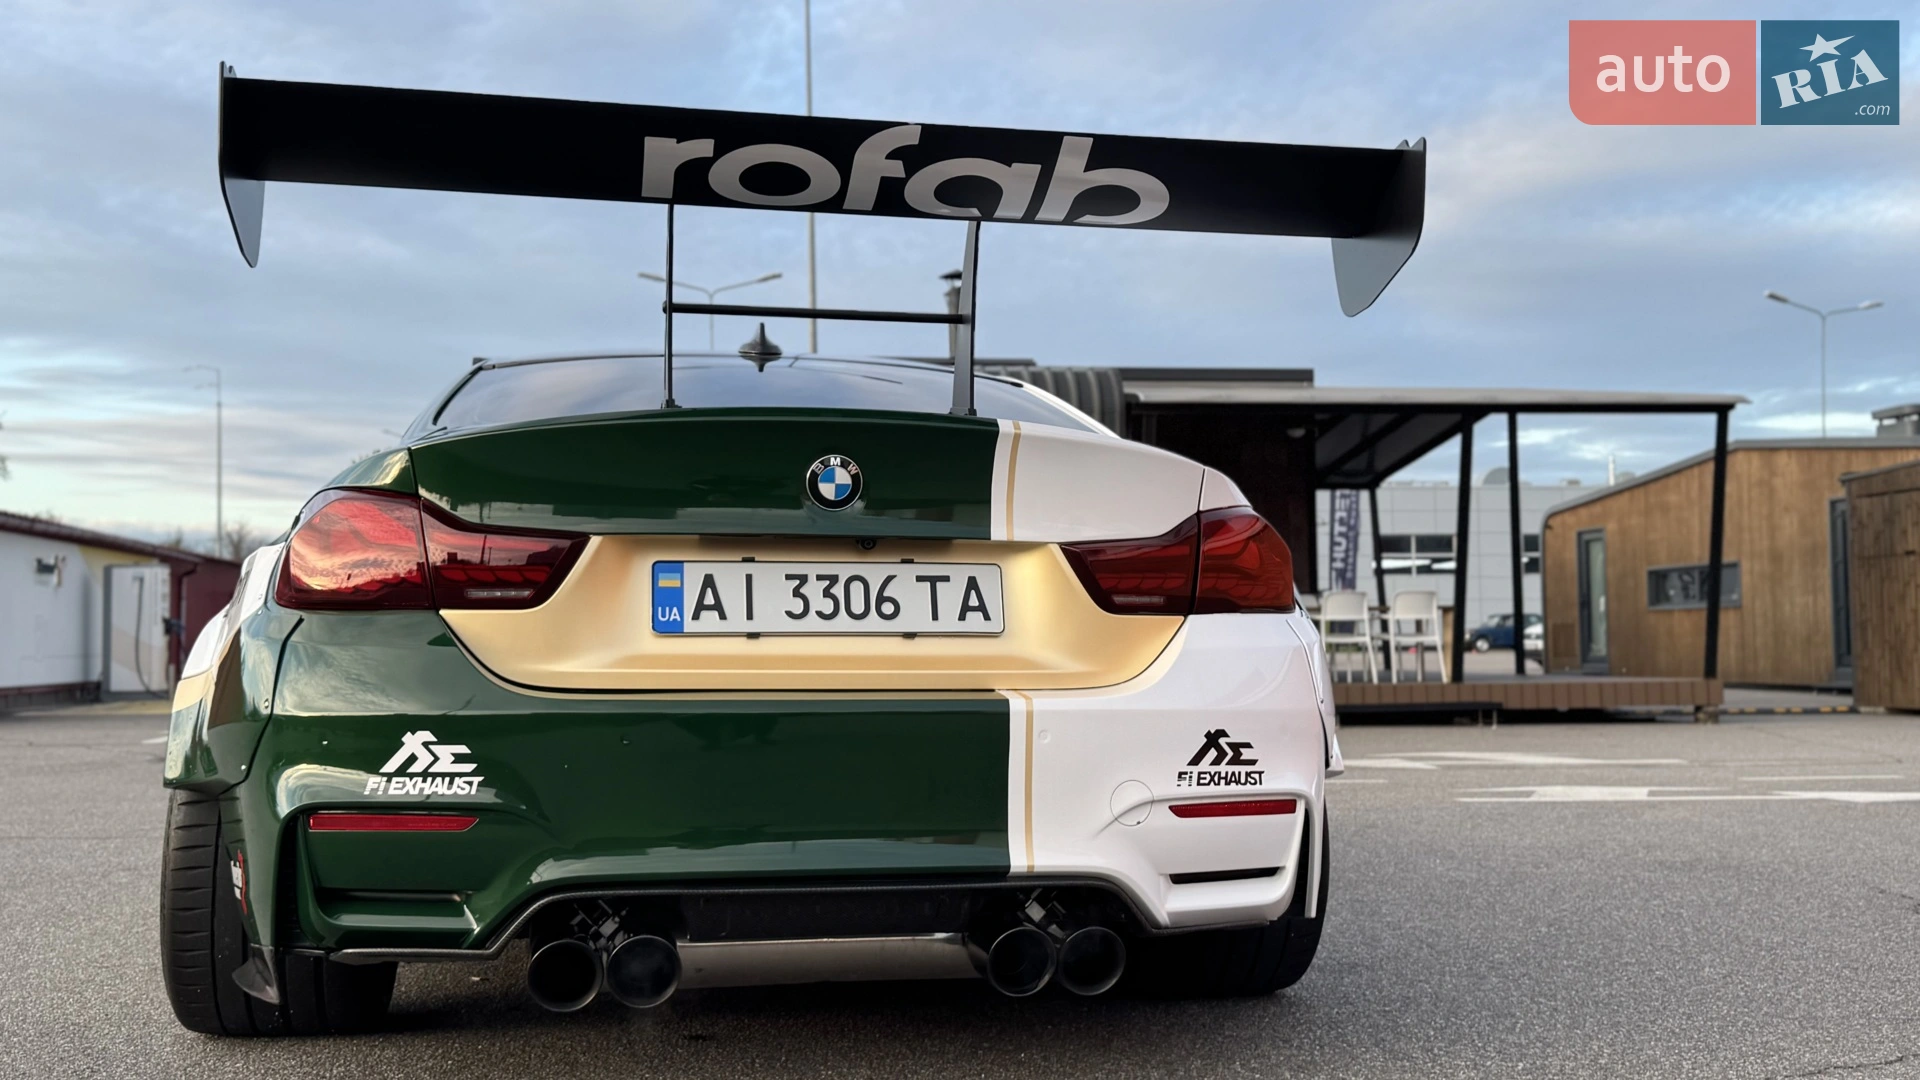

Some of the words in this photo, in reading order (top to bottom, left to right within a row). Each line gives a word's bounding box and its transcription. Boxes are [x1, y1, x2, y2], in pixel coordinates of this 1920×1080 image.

[641, 124, 1170, 225] rofab
[812, 456, 860, 476] BMW
[691, 573, 754, 621] AI
[784, 574, 901, 621] 3306
[915, 575, 992, 622] TA
[658, 606, 681, 622] UA
[388, 776, 485, 795] EXHAUST
[1196, 770, 1265, 787] EXHAUST
